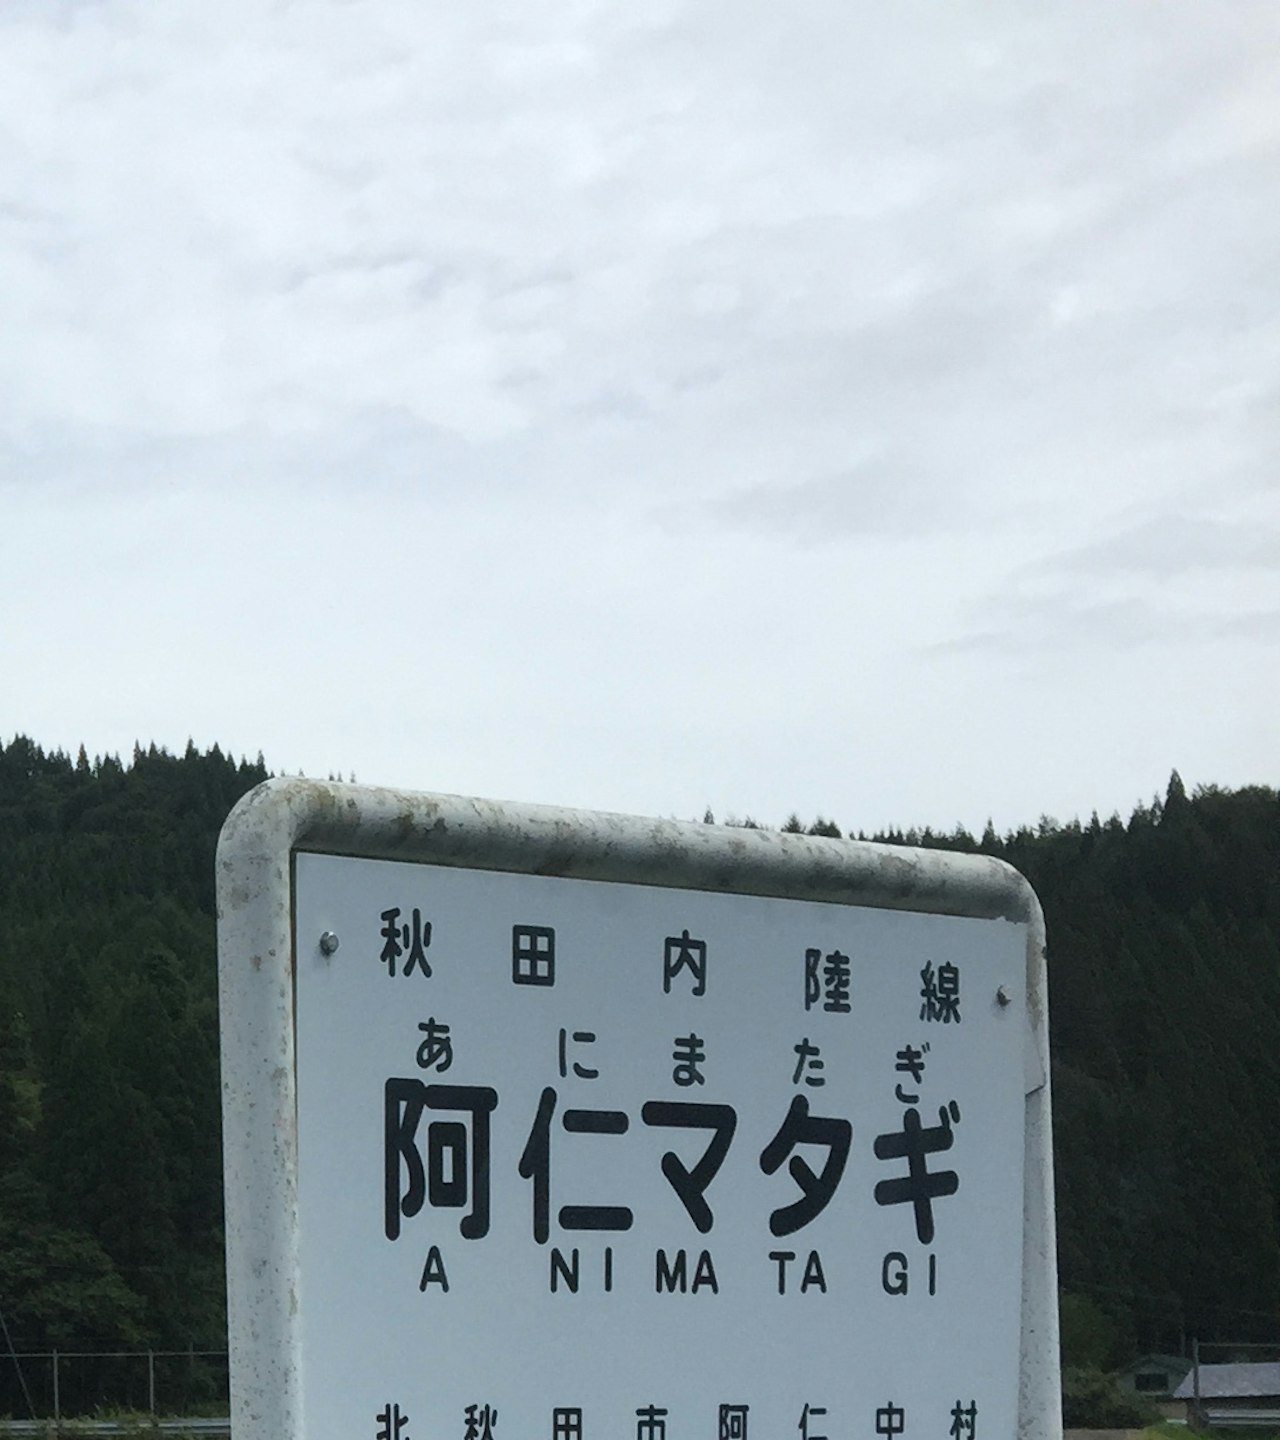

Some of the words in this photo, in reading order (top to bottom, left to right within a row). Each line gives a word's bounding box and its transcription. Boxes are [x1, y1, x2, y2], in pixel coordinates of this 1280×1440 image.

[379, 907, 962, 1024] 秋田内陸線
[415, 1016, 931, 1105] あにまたぎ
[384, 1077, 960, 1245] 阿仁マタギ
[419, 1245, 450, 1293] A
[550, 1246, 613, 1294] NI
[655, 1248, 719, 1295] MA
[768, 1249, 827, 1295] TA
[881, 1251, 936, 1296] GI
